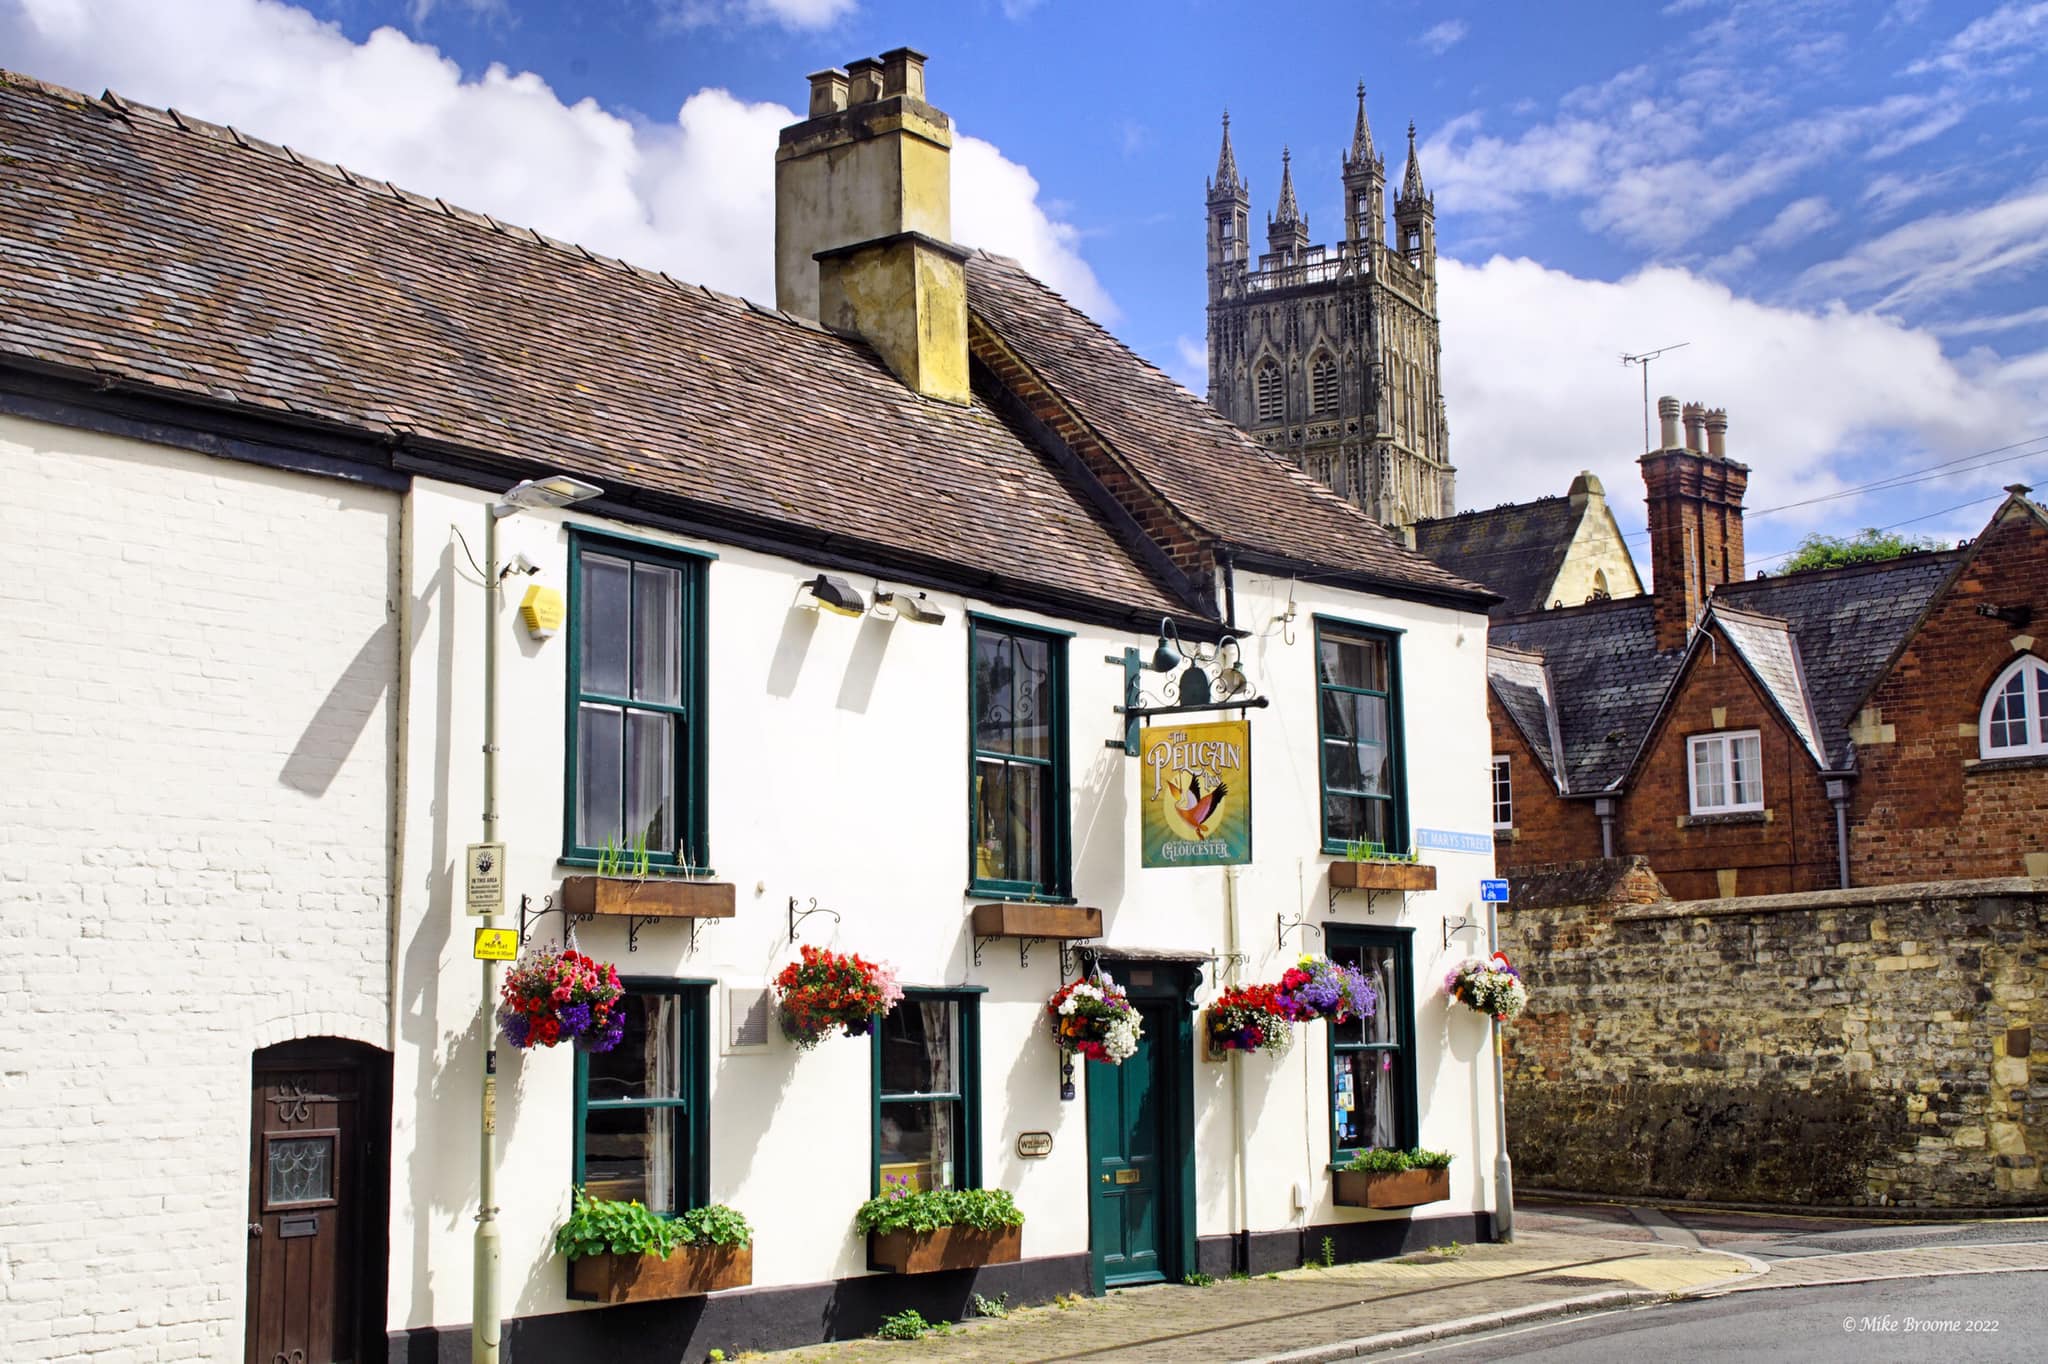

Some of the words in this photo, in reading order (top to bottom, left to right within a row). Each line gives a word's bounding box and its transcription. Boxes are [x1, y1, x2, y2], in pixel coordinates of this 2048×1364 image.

[1147, 741, 1240, 801] PELICAN
[1162, 841, 1231, 862] GLOUCESTER
[1461, 836, 1491, 850] STREET
